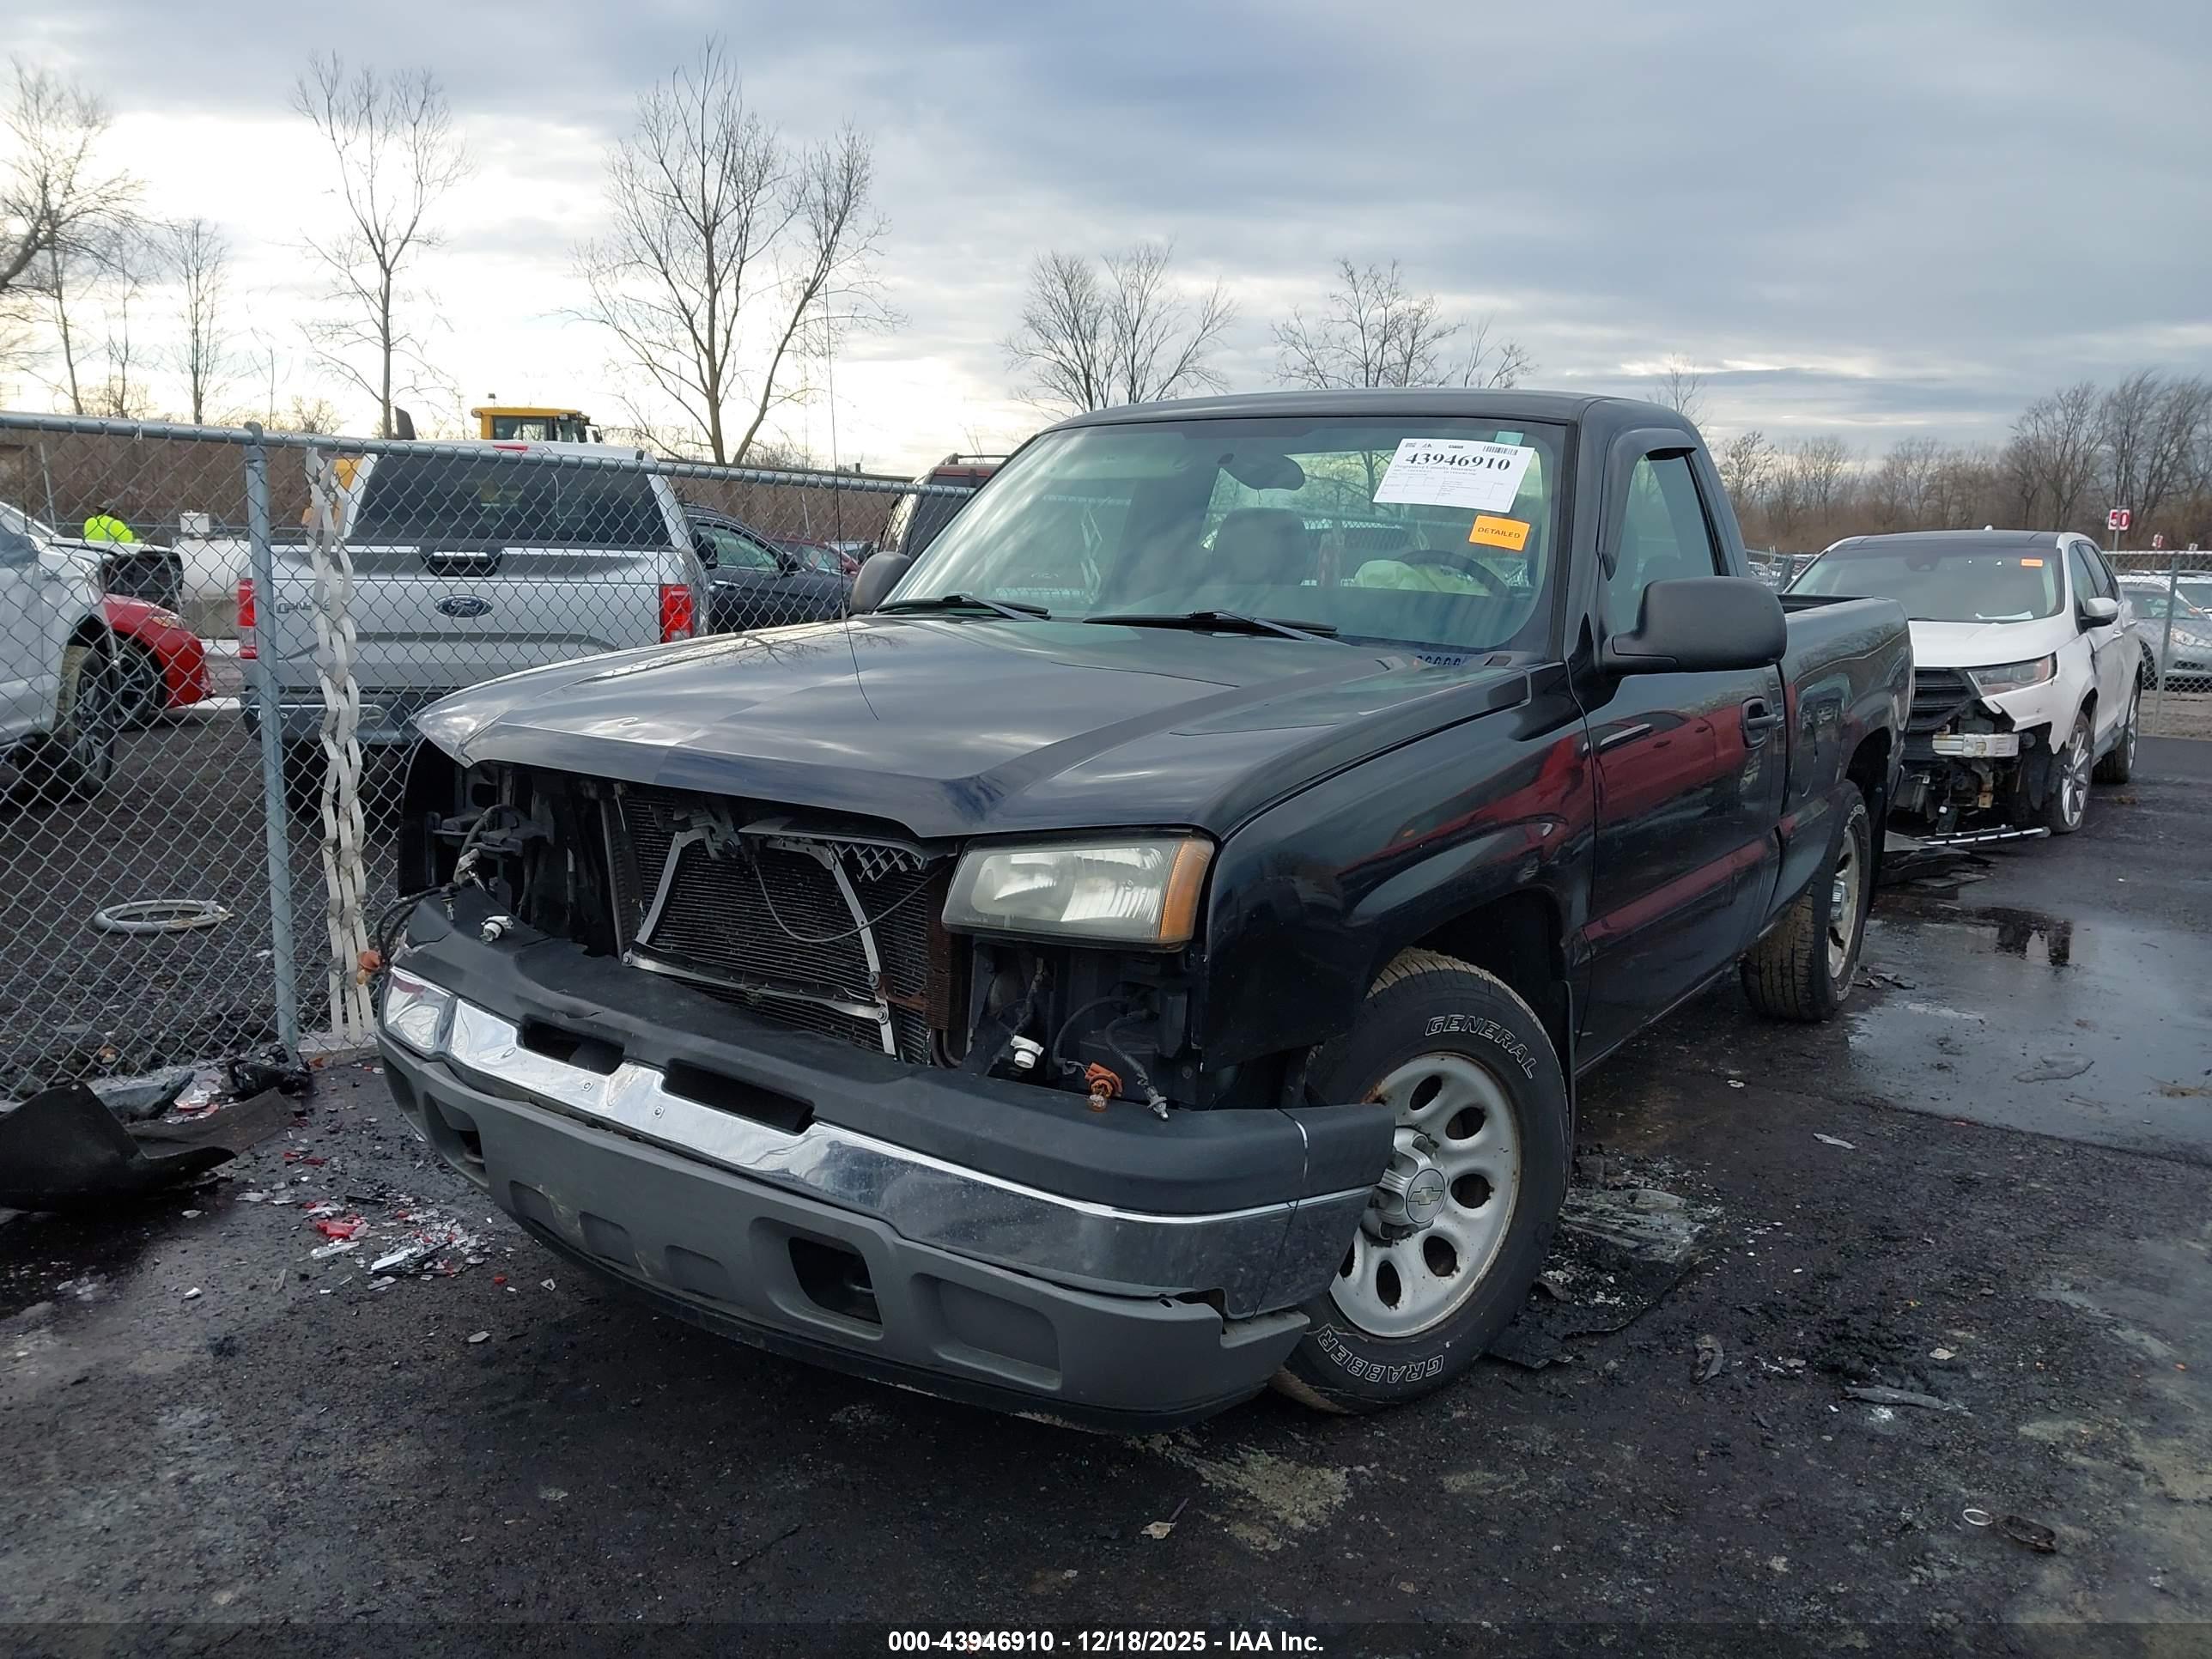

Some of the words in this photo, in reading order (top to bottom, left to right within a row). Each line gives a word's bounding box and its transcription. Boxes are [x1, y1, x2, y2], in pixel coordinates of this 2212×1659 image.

[1405, 453, 1510, 471] 43946910
[2110, 512, 2130, 527] 50
[1477, 526, 1521, 539] DETAILED
[1425, 1014, 1537, 1079] GENERAL
[1317, 1329, 1444, 1384] GRABBER
